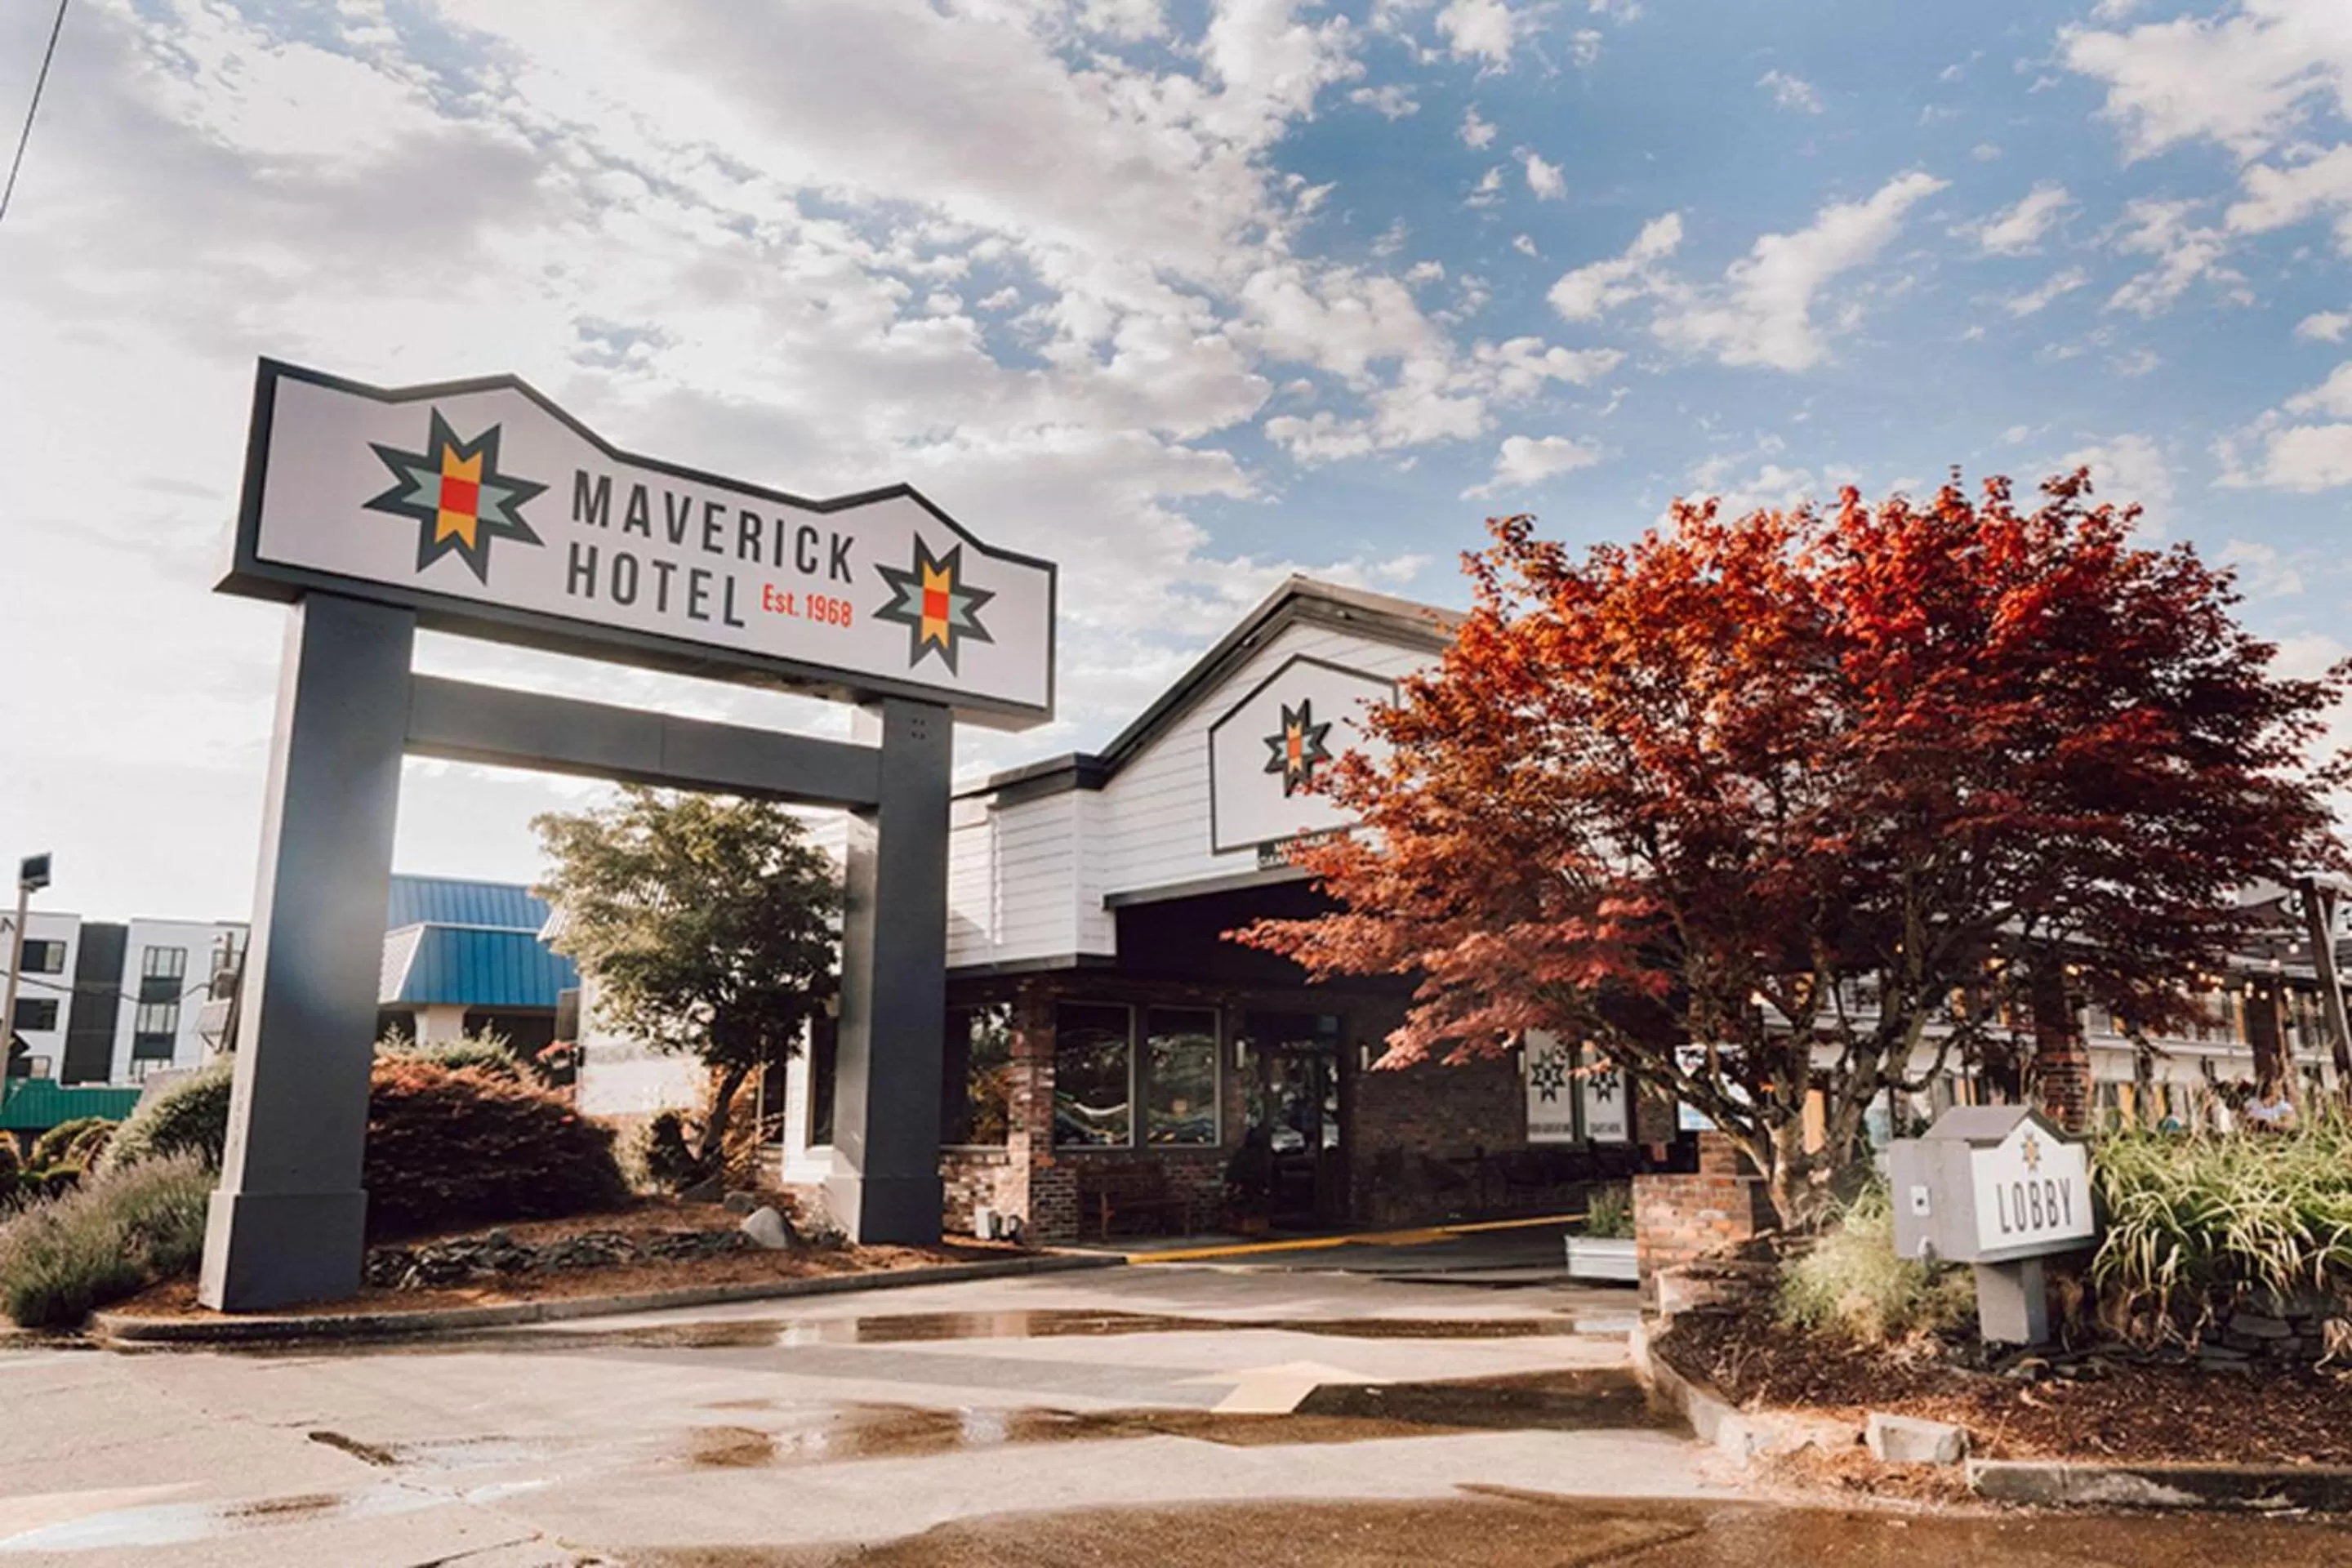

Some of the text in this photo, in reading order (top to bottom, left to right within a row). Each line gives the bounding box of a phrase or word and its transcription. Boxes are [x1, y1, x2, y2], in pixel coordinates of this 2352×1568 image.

[572, 469, 854, 583] MAVERICK
[567, 541, 746, 629] HOTEL
[761, 582, 853, 627] Est. 1968
[1996, 1177, 2073, 1234] LOBBY
